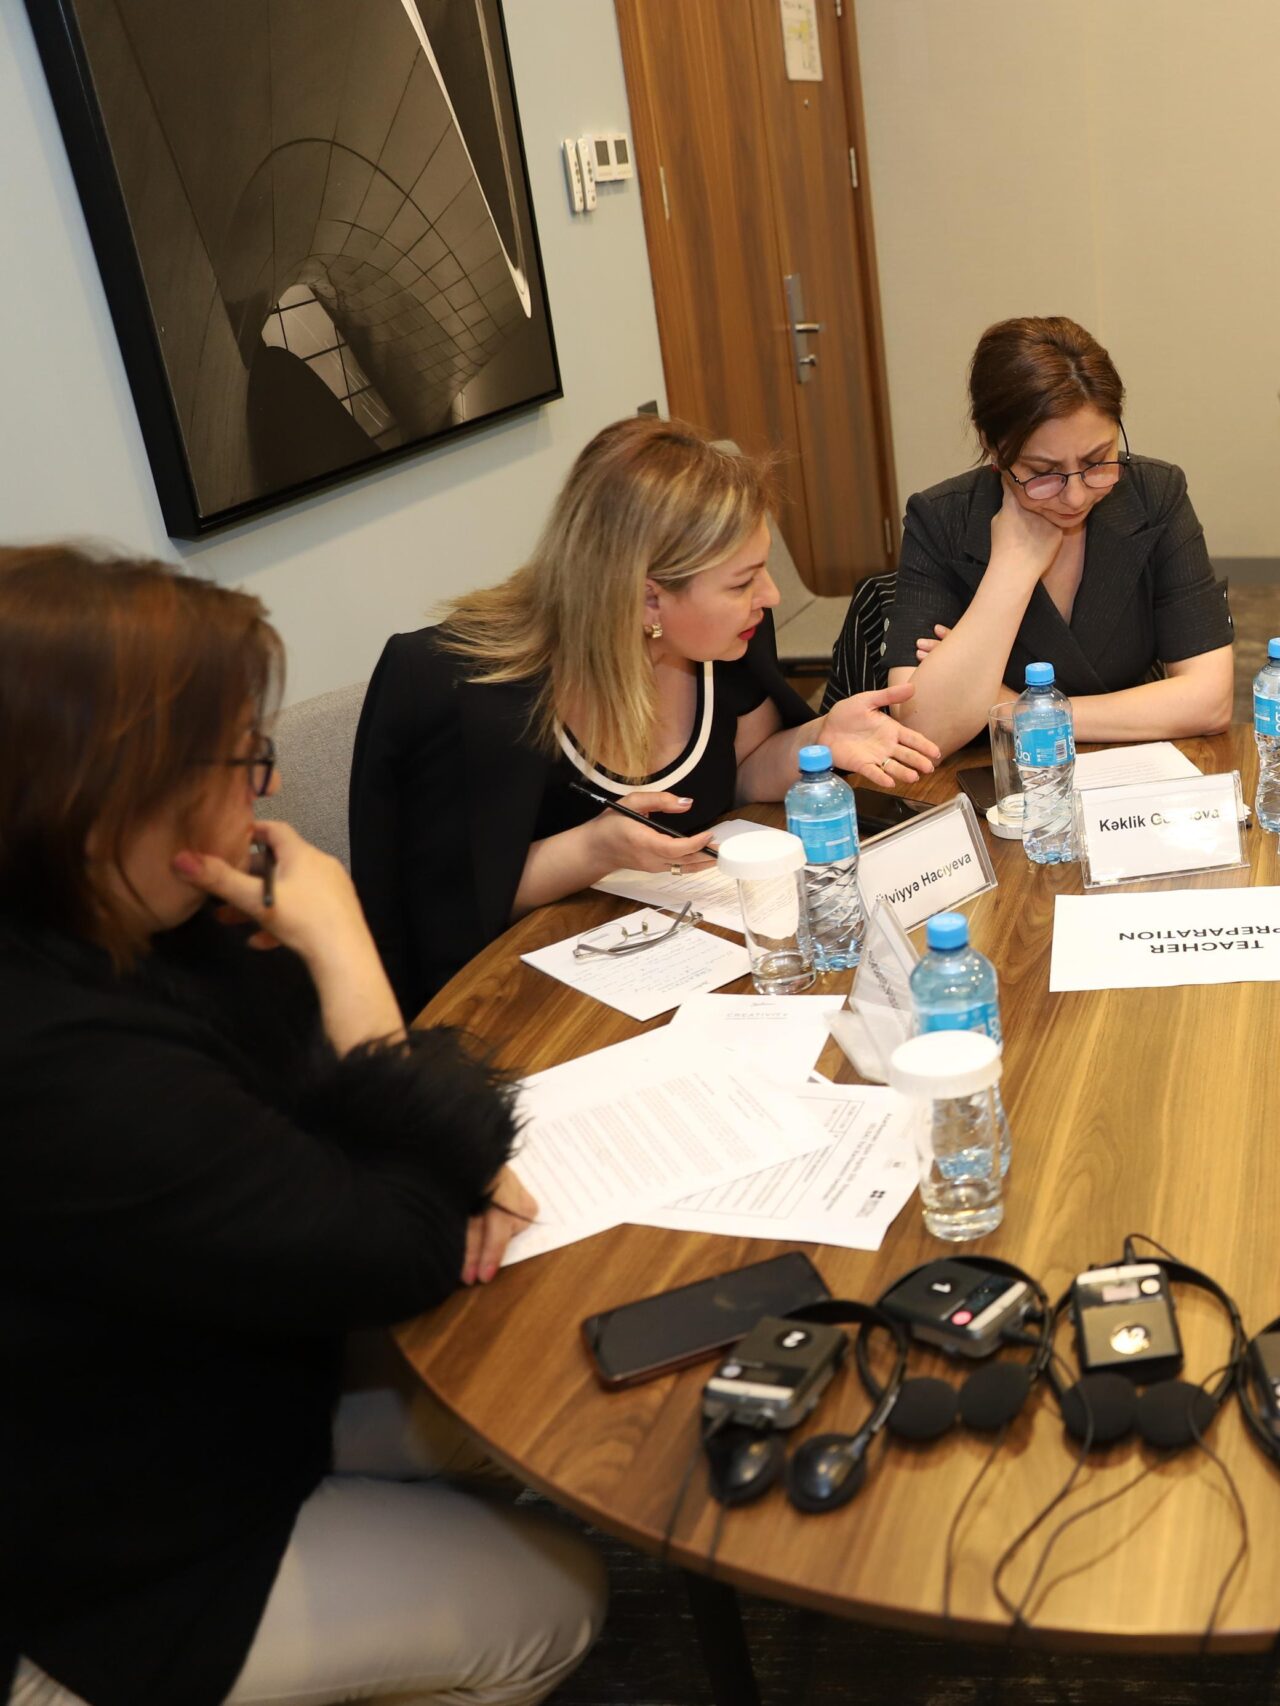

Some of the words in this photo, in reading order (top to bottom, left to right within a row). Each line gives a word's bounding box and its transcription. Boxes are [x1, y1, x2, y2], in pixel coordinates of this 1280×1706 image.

[1099, 815, 1146, 832] Kəklik
[920, 853, 972, 887] Hacıyeva
[1150, 940, 1264, 954] TEACHER
